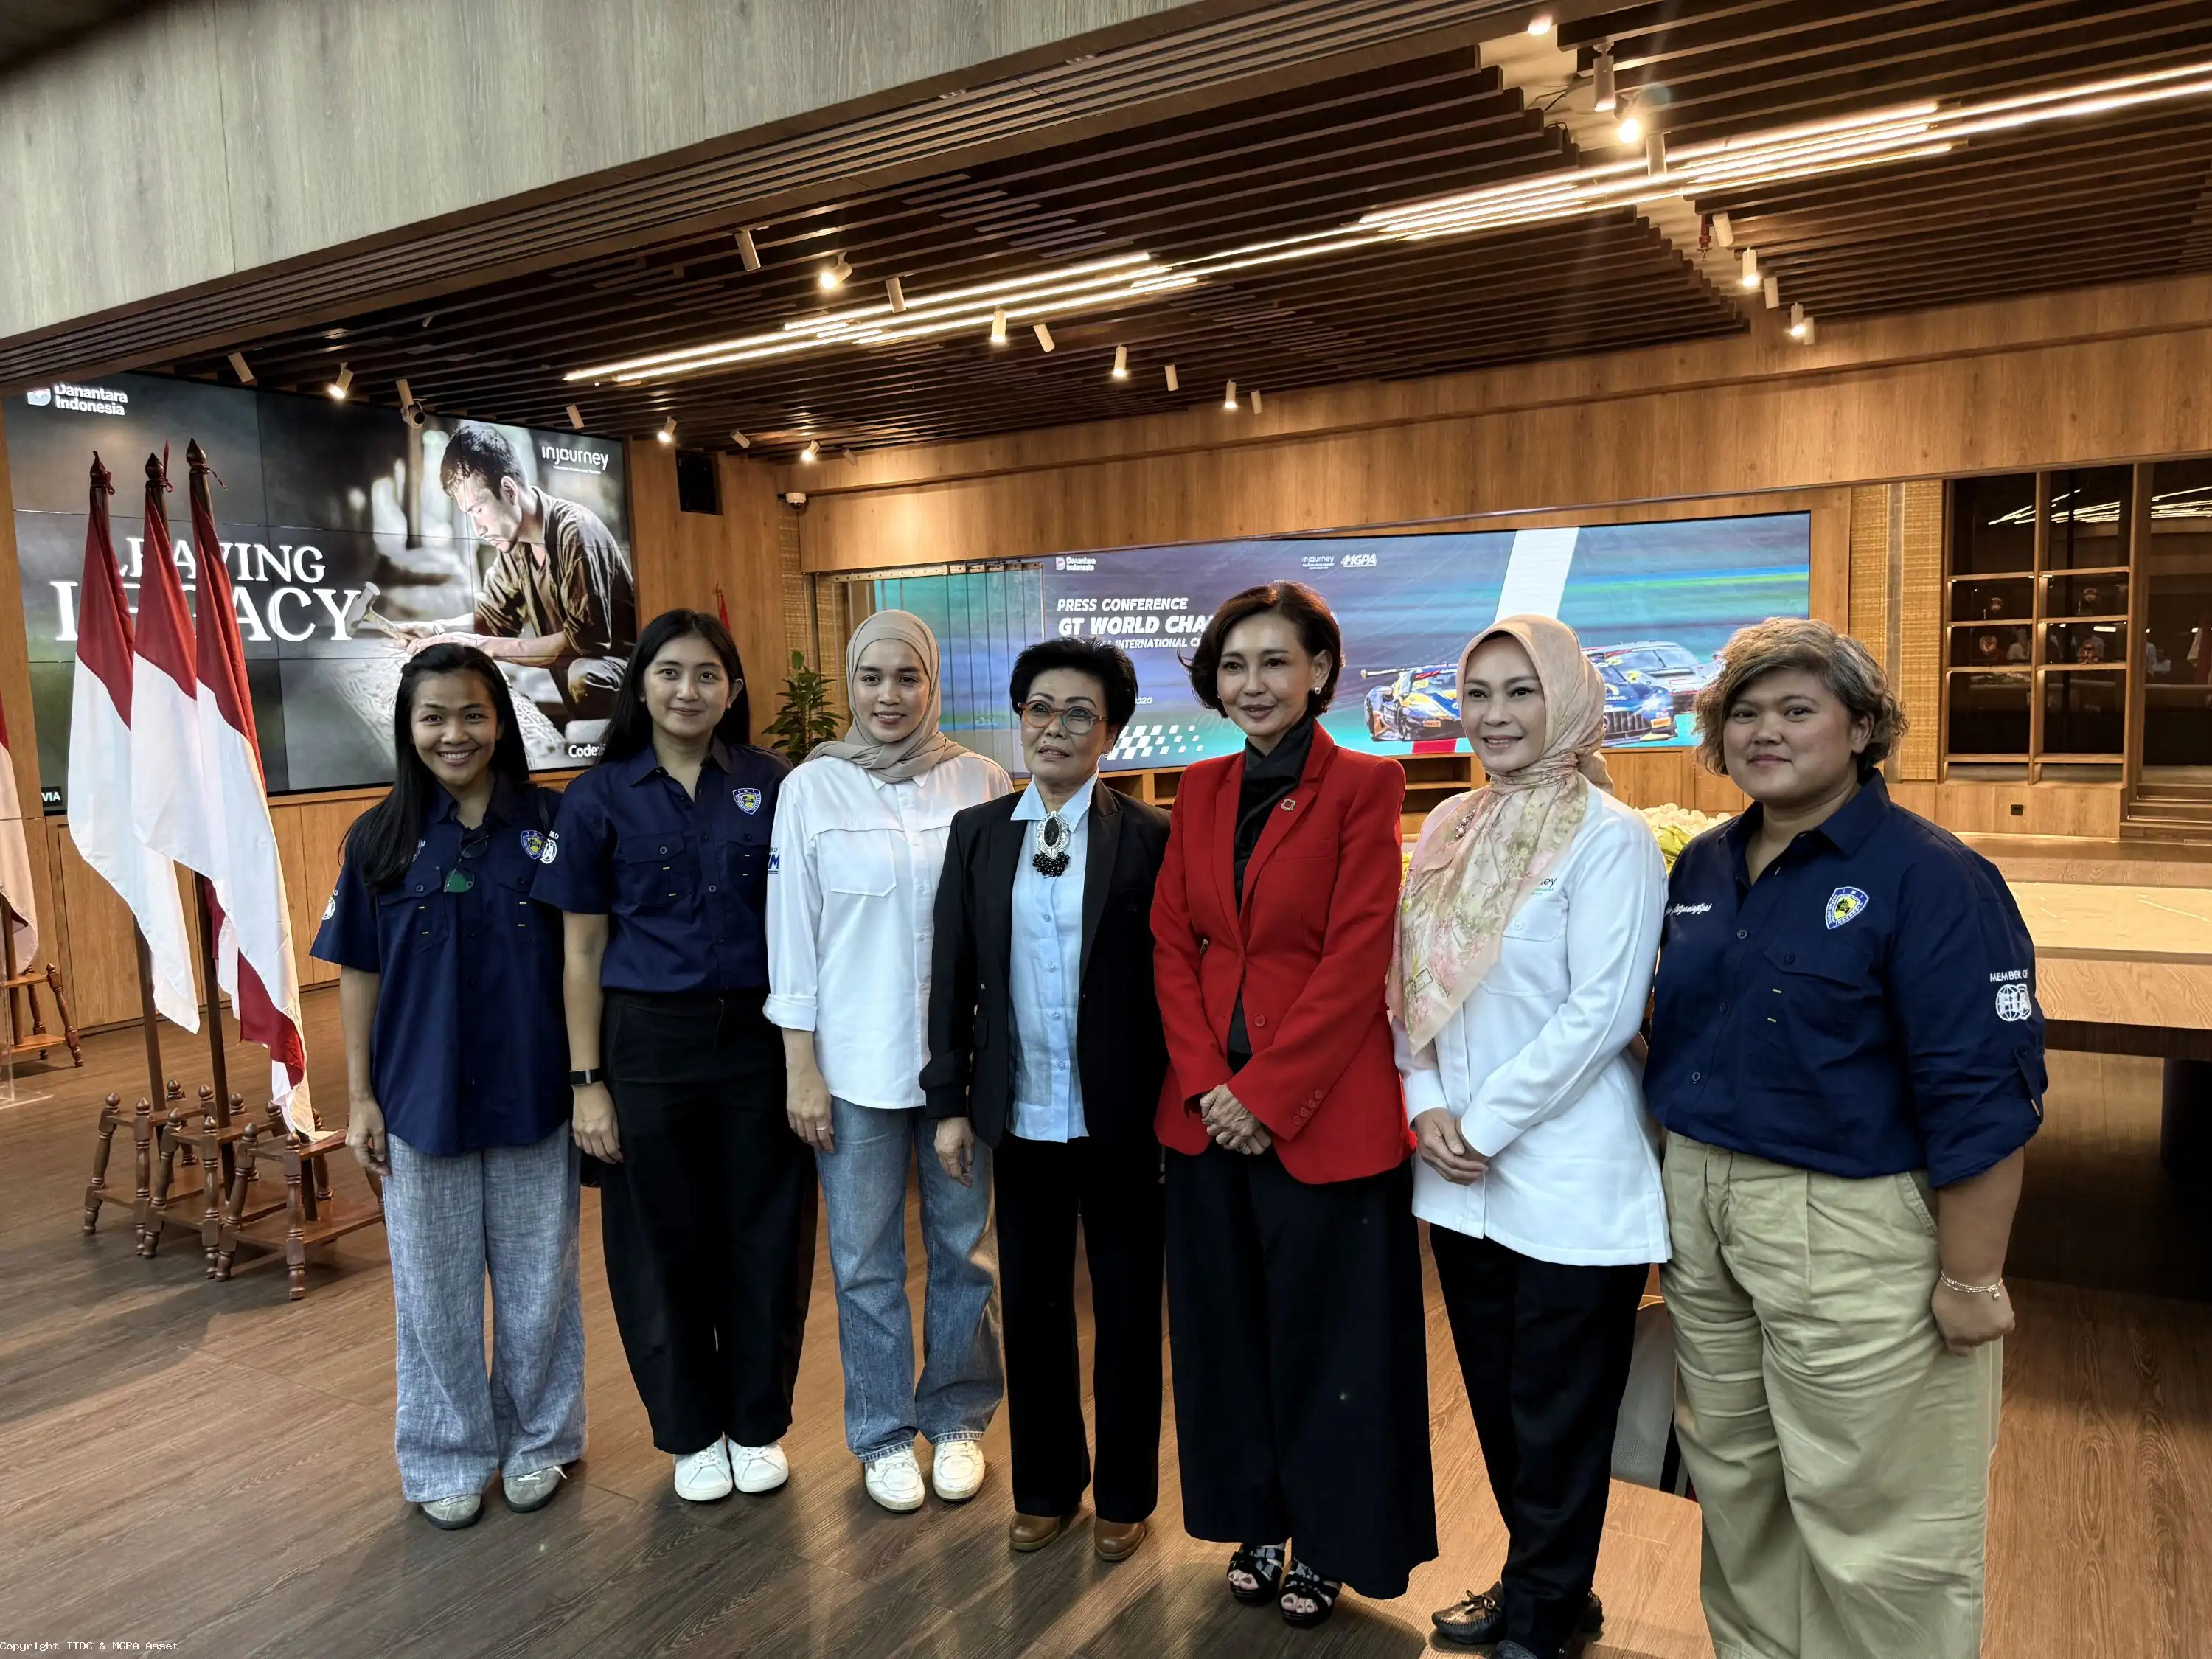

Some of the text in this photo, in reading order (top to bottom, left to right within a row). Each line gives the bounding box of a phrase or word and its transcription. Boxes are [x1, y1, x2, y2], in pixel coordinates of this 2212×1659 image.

[54, 383, 128, 403] Danantara
[55, 395, 125, 416] Indonesia
[1057, 597, 1189, 611] PRESS CONFERENCE
[1058, 614, 1214, 636] GT WORLD CHA
[1116, 638, 1188, 649] INTERNATIONAL
[568, 743, 599, 758] Code
[41, 791, 61, 801] VIA
[1989, 970, 2022, 983] MEMBER
